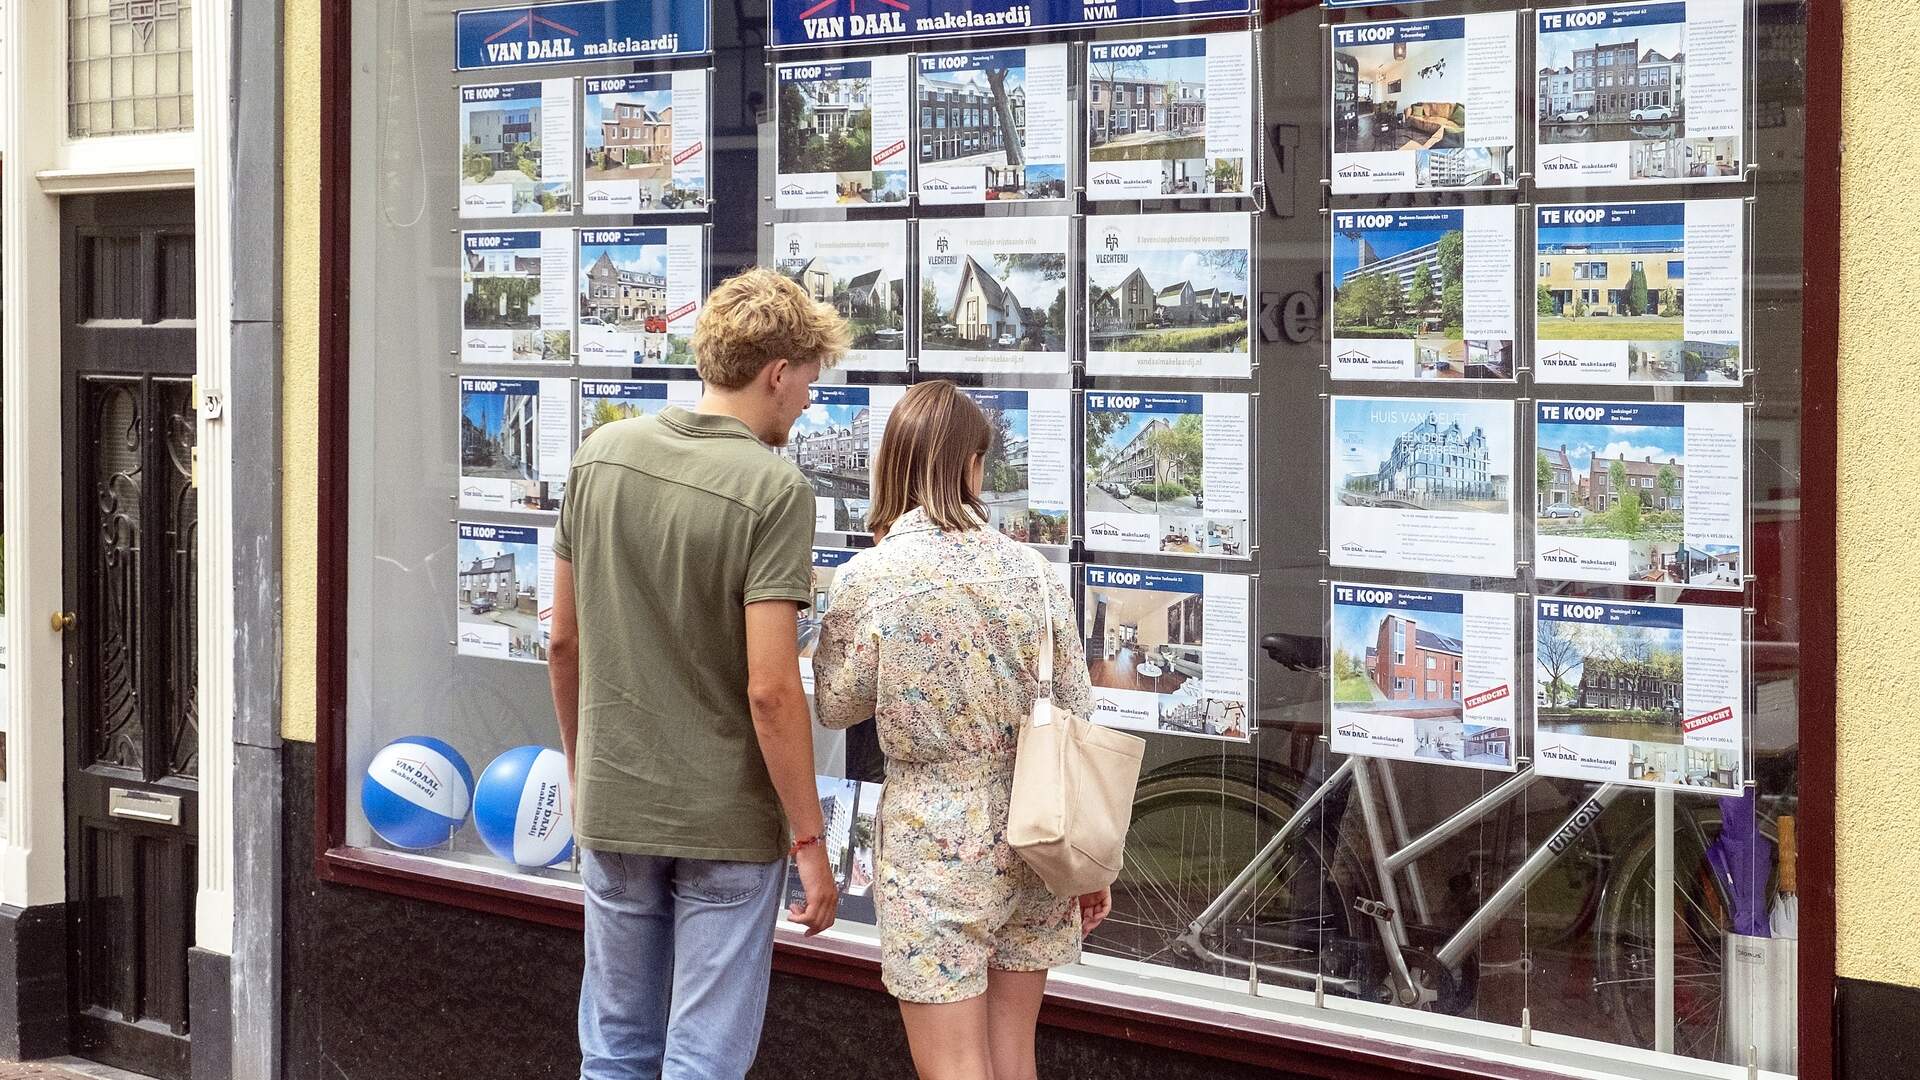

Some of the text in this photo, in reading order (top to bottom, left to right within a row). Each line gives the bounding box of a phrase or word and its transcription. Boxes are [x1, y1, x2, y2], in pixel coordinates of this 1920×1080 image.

[1083, 5, 1118, 20] NVM
[804, 6, 1031, 39] VAN DAAL makelaardij
[1542, 12, 1606, 29] TE KOOP
[1338, 29, 1354, 43] TE
[1358, 26, 1394, 42] KOOP
[487, 34, 678, 62] VAN DAAL makelaardij
[1093, 47, 1108, 59] TE
[1110, 44, 1143, 58] KOOP
[921, 58, 936, 70] TE
[938, 56, 968, 69] KOOP
[780, 69, 794, 80] TE
[794, 66, 822, 79] KOOP
[588, 81, 600, 92] TE
[601, 79, 626, 91] KOOP
[464, 90, 474, 100] TE
[476, 88, 500, 99] KOOP
[1336, 214, 1394, 228] TE KOOP
[1541, 209, 1606, 224] TE KOOP
[466, 238, 478, 248] TE
[478, 236, 501, 248] KOOP
[582, 232, 595, 243] TE
[596, 232, 621, 243] KOOP
[1136, 358, 1202, 368] vandaalmakelaardij.nl
[462, 380, 473, 391] TE
[474, 380, 498, 392] KOOP
[583, 384, 595, 395] TE
[596, 384, 621, 396] KOOP
[1090, 396, 1140, 409] TE KOOP
[1370, 410, 1398, 424] HUIS
[1400, 412, 1426, 424] VAN
[1541, 406, 1605, 421] TE KOOP
[1402, 432, 1423, 444] EEN
[1424, 432, 1444, 444] ODE
[1402, 443, 1415, 455] DE
[460, 526, 472, 536] TE
[473, 526, 496, 538] KOOP
[1558, 556, 1578, 564] DAAL
[1090, 570, 1141, 586] TE KOOP
[1336, 588, 1353, 602] TE
[1357, 589, 1394, 604] KOOP
[1540, 602, 1604, 620] TE KOOP
[1466, 688, 1508, 706] VERKOCHT
[1684, 710, 1730, 729] VERKOCHT
[1580, 758, 1616, 766] makelaardij
[390, 768, 434, 798] makelaardij
[396, 760, 439, 791] VAN DAAL
[528, 782, 546, 836] makelaardij
[538, 784, 557, 838] VAN DAAL
[1549, 801, 1600, 852] UNION
